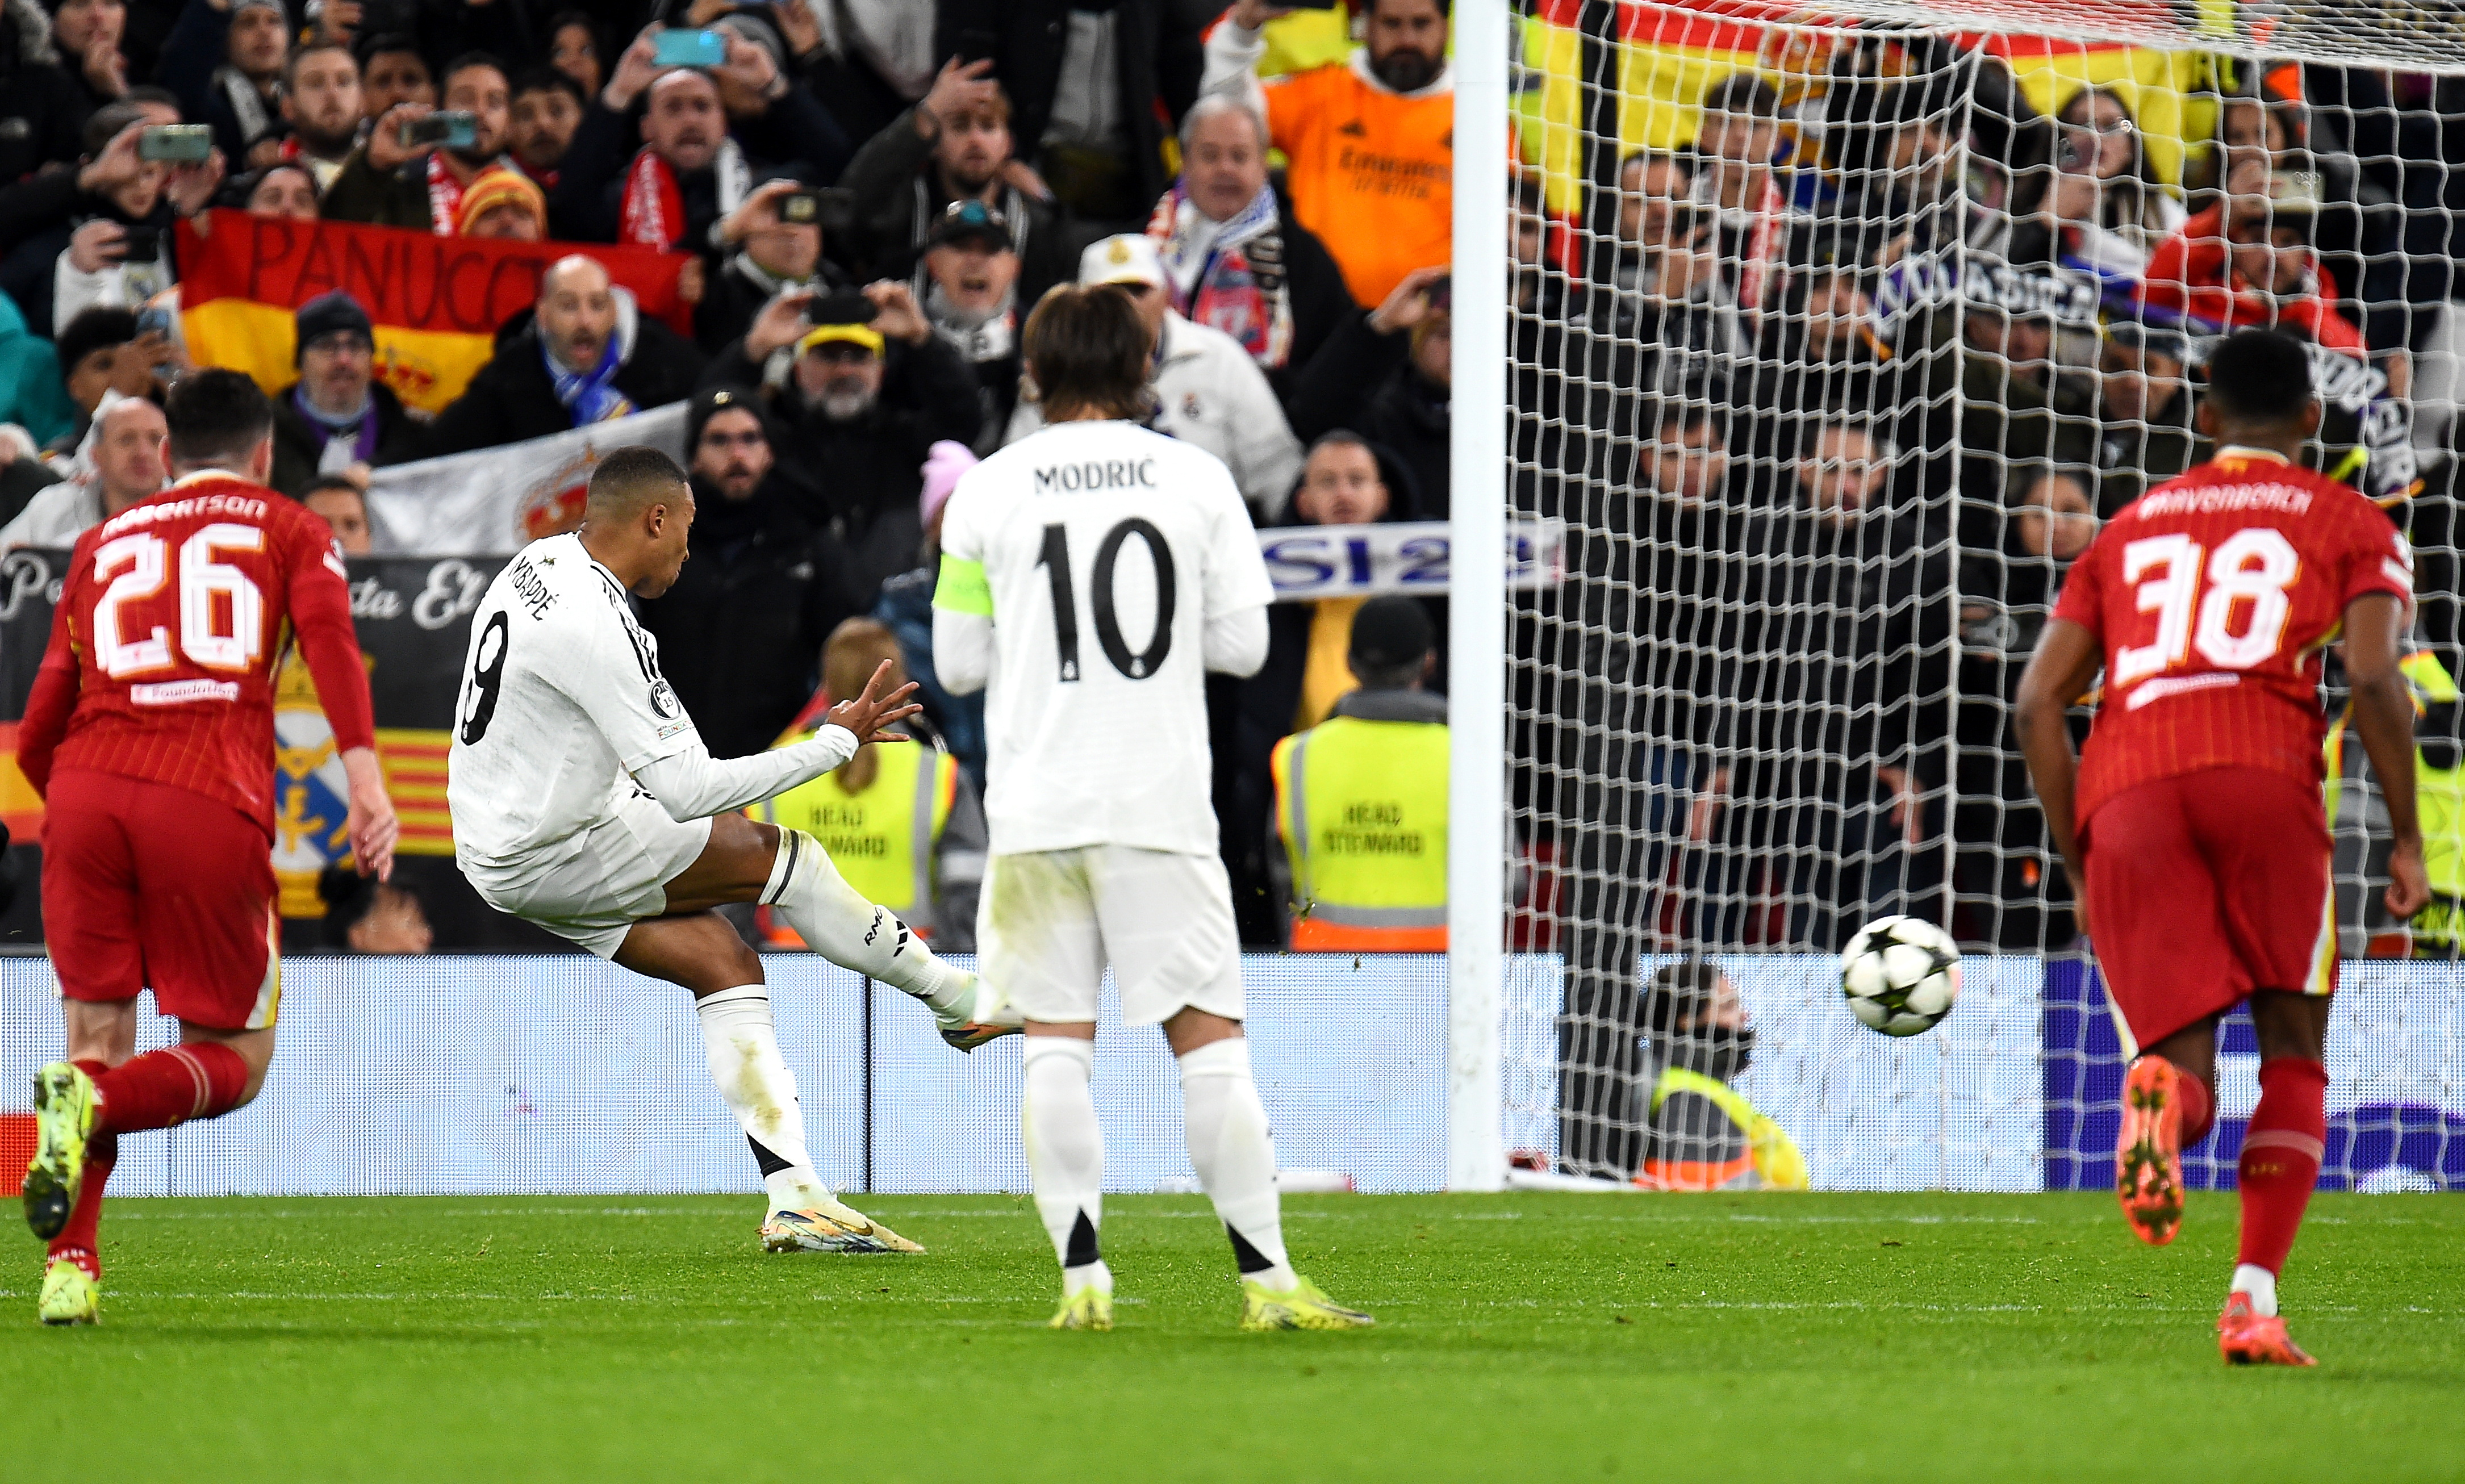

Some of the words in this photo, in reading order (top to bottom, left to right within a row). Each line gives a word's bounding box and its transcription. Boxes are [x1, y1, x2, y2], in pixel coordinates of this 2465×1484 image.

[1033, 453, 1157, 495] MODRIĆ
[93, 523, 268, 680] 26
[508, 555, 560, 621] MBAPPÉ
[1033, 516, 1176, 682] 10
[2113, 527, 2303, 688] 38
[461, 609, 509, 746] 9
[663, 696, 674, 708] 15
